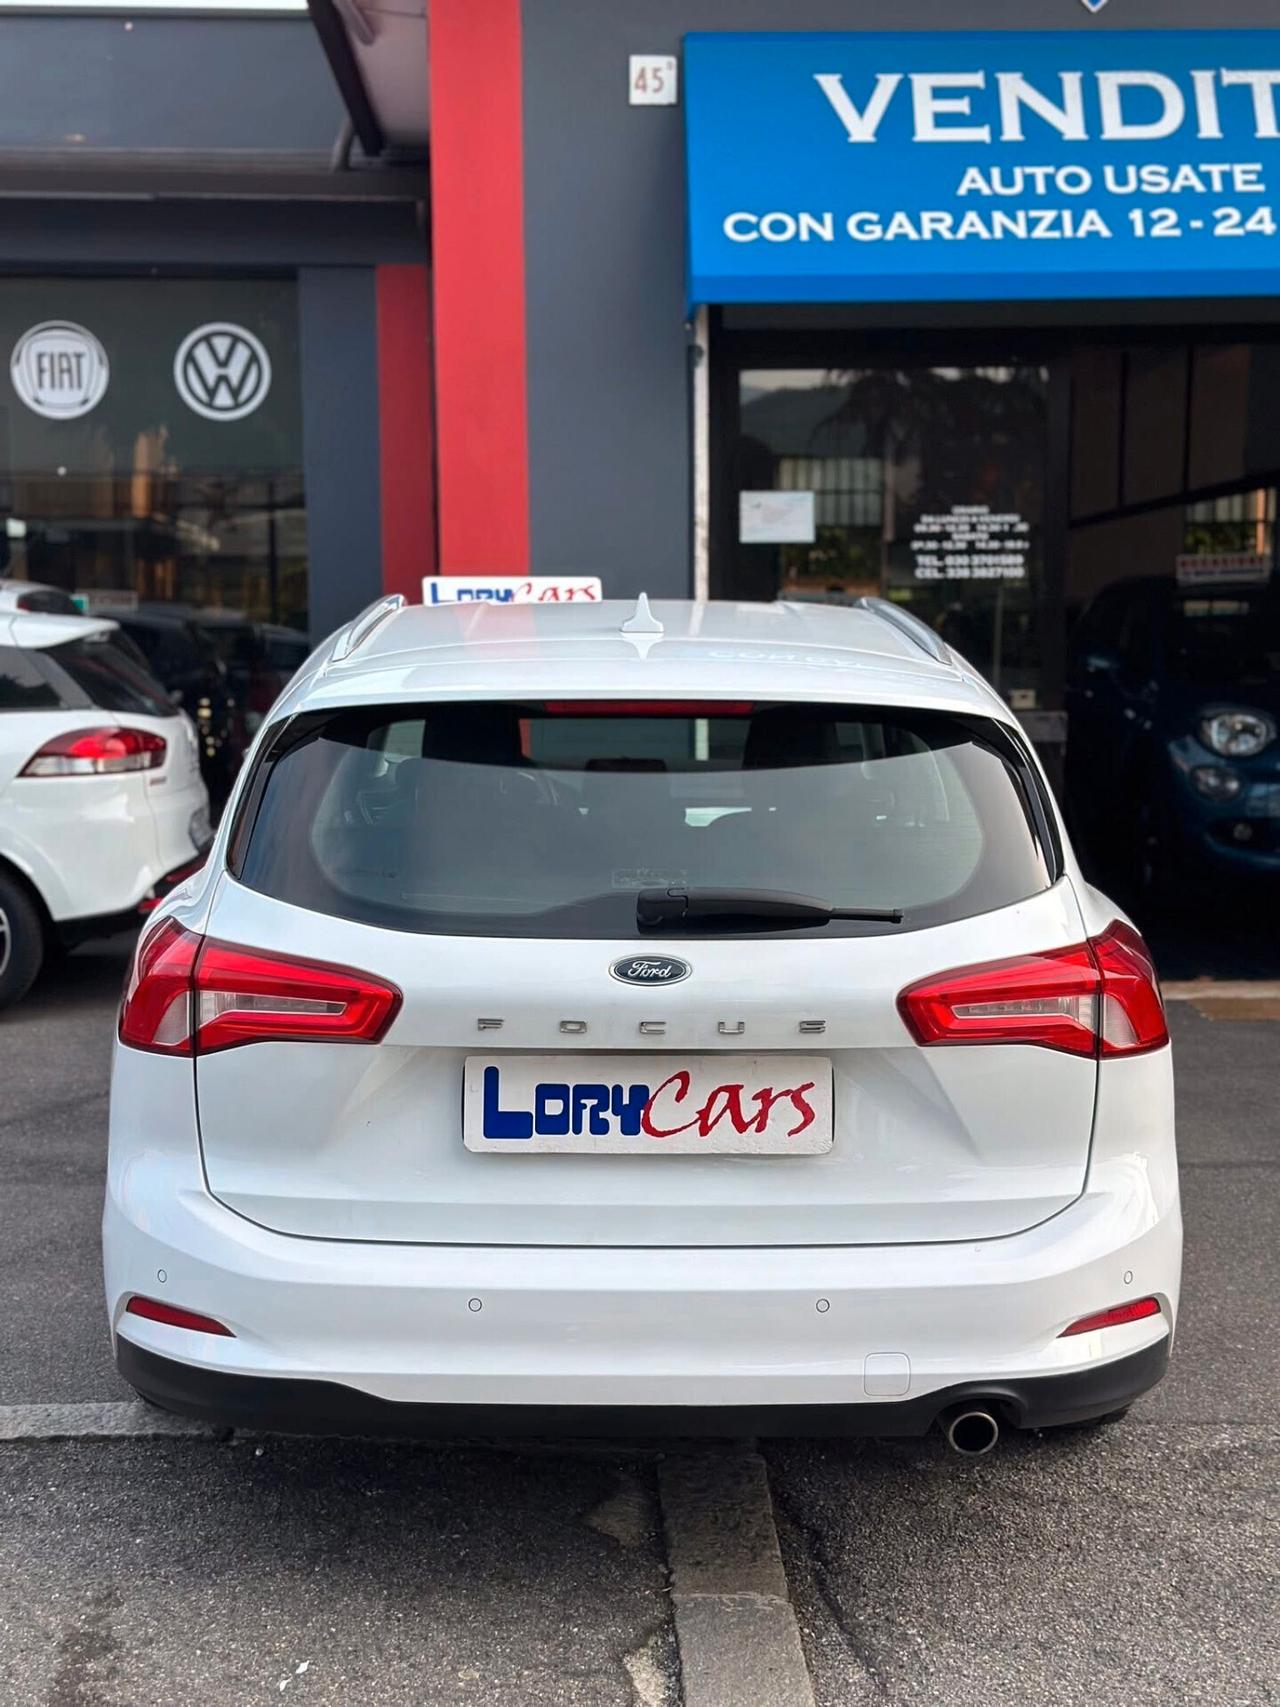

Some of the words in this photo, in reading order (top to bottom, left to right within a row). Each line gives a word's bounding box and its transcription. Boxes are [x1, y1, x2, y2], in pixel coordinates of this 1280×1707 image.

[813, 68, 1280, 144] VENDIT
[956, 165, 1093, 197] AUTO
[1103, 163, 1266, 194] USATE
[723, 211, 834, 242] CON
[846, 208, 1113, 240] GARANZIA
[1128, 207, 1182, 238] 12
[1212, 206, 1277, 236] 24
[36, 351, 86, 392] FIAT
[627, 960, 672, 978] Ford
[477, 1018, 826, 1035] FOCUS
